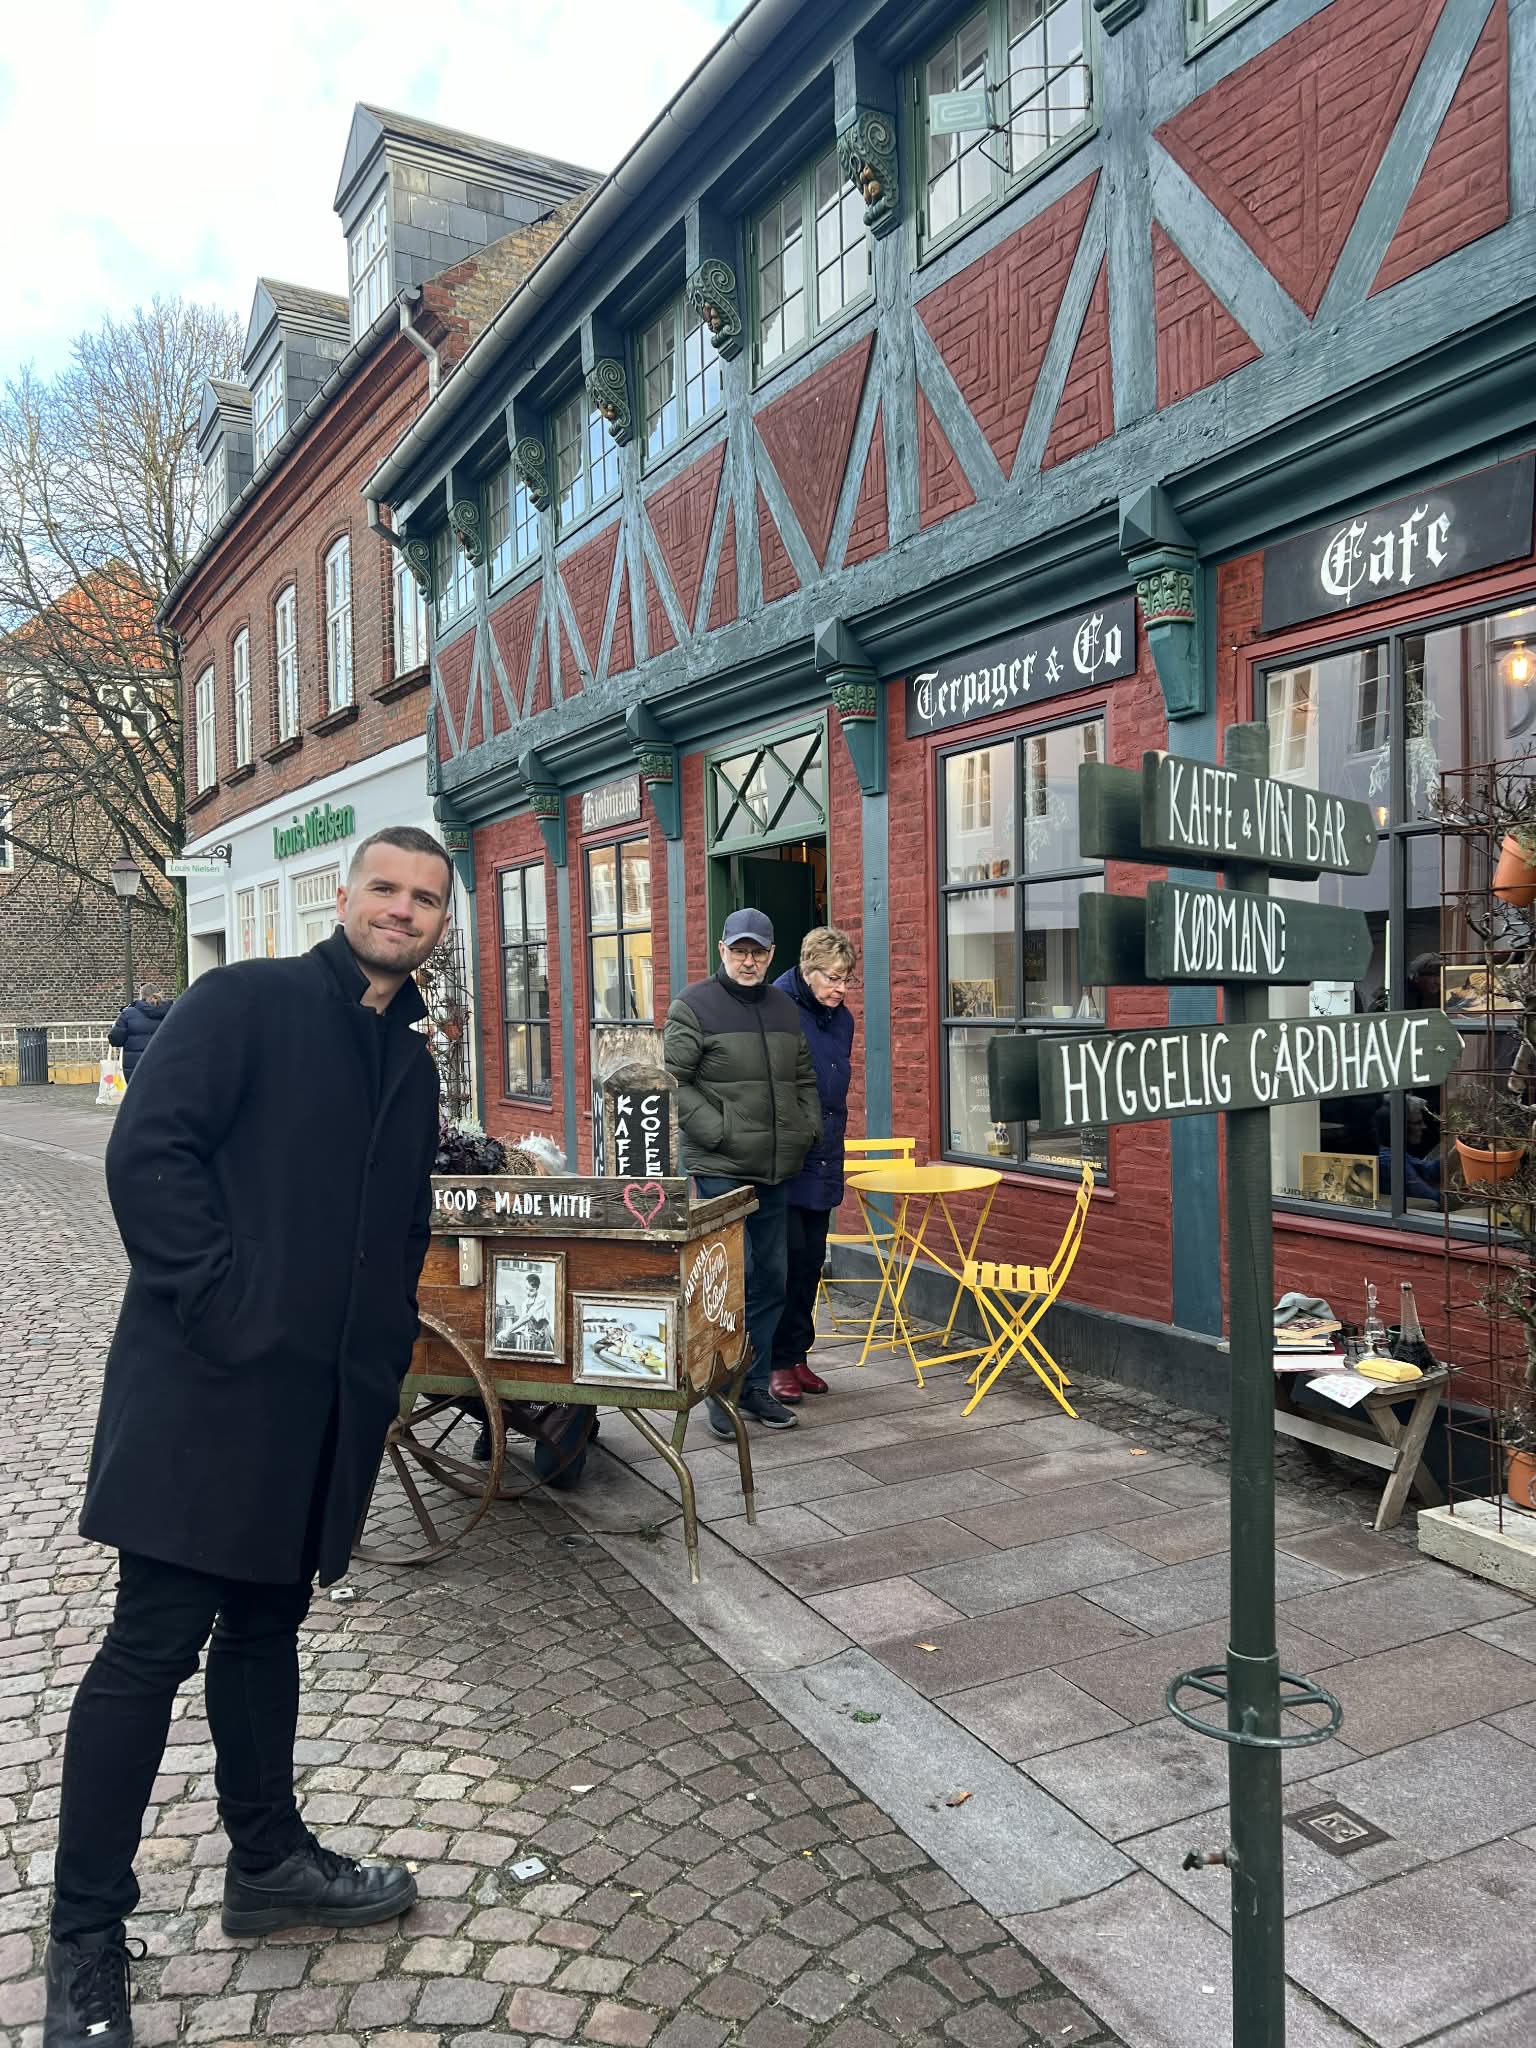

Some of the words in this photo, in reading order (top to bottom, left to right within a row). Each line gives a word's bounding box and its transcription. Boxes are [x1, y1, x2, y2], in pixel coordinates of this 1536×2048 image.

[1320, 503, 1451, 606] Cafe
[913, 648, 1039, 727] Terpager
[1044, 645, 1064, 686] &
[1072, 612, 1124, 683] Co
[272, 814, 305, 861] Louis
[303, 802, 355, 850] Nielsen
[1167, 758, 1239, 852] KAFFE
[1240, 809, 1253, 840] &
[1253, 777, 1295, 860] VIN
[1304, 791, 1351, 868] BAR
[169, 863, 192, 874] Louis
[192, 864, 221, 875] Nielsen
[1172, 888, 1287, 976] KØBMAND
[1059, 1029, 1232, 1127] HYGGELIG
[1248, 1016, 1432, 1103] GÅRDHAVE
[434, 1189, 478, 1212] FOOD
[494, 1190, 544, 1217] MADE
[549, 1193, 592, 1220] WITH
[684, 1243, 709, 1305] NATURAL
